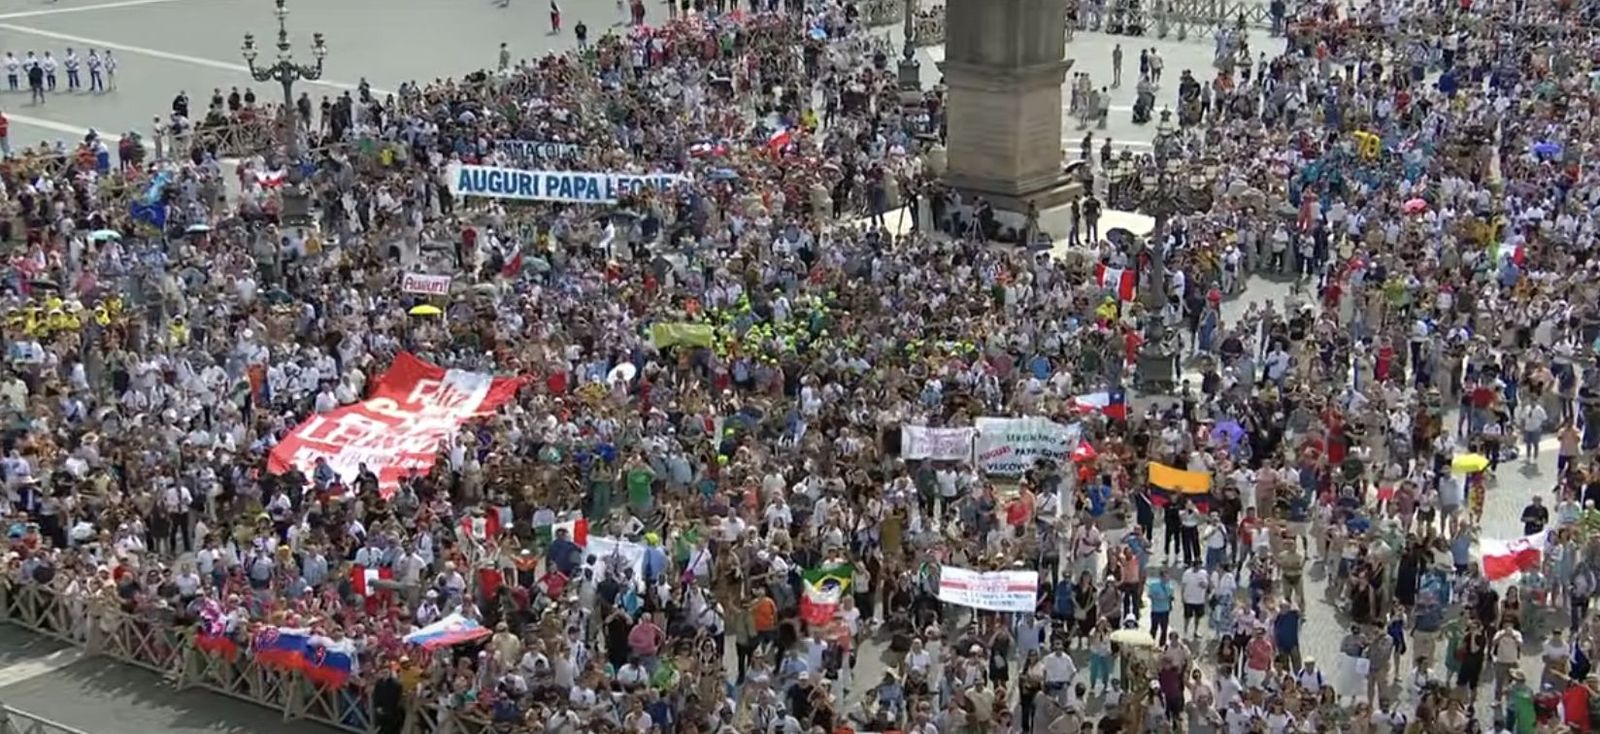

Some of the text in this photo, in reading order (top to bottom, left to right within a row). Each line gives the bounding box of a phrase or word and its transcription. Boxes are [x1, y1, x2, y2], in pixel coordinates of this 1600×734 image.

[457, 169, 673, 200] AUGURI PAPA LEONE
